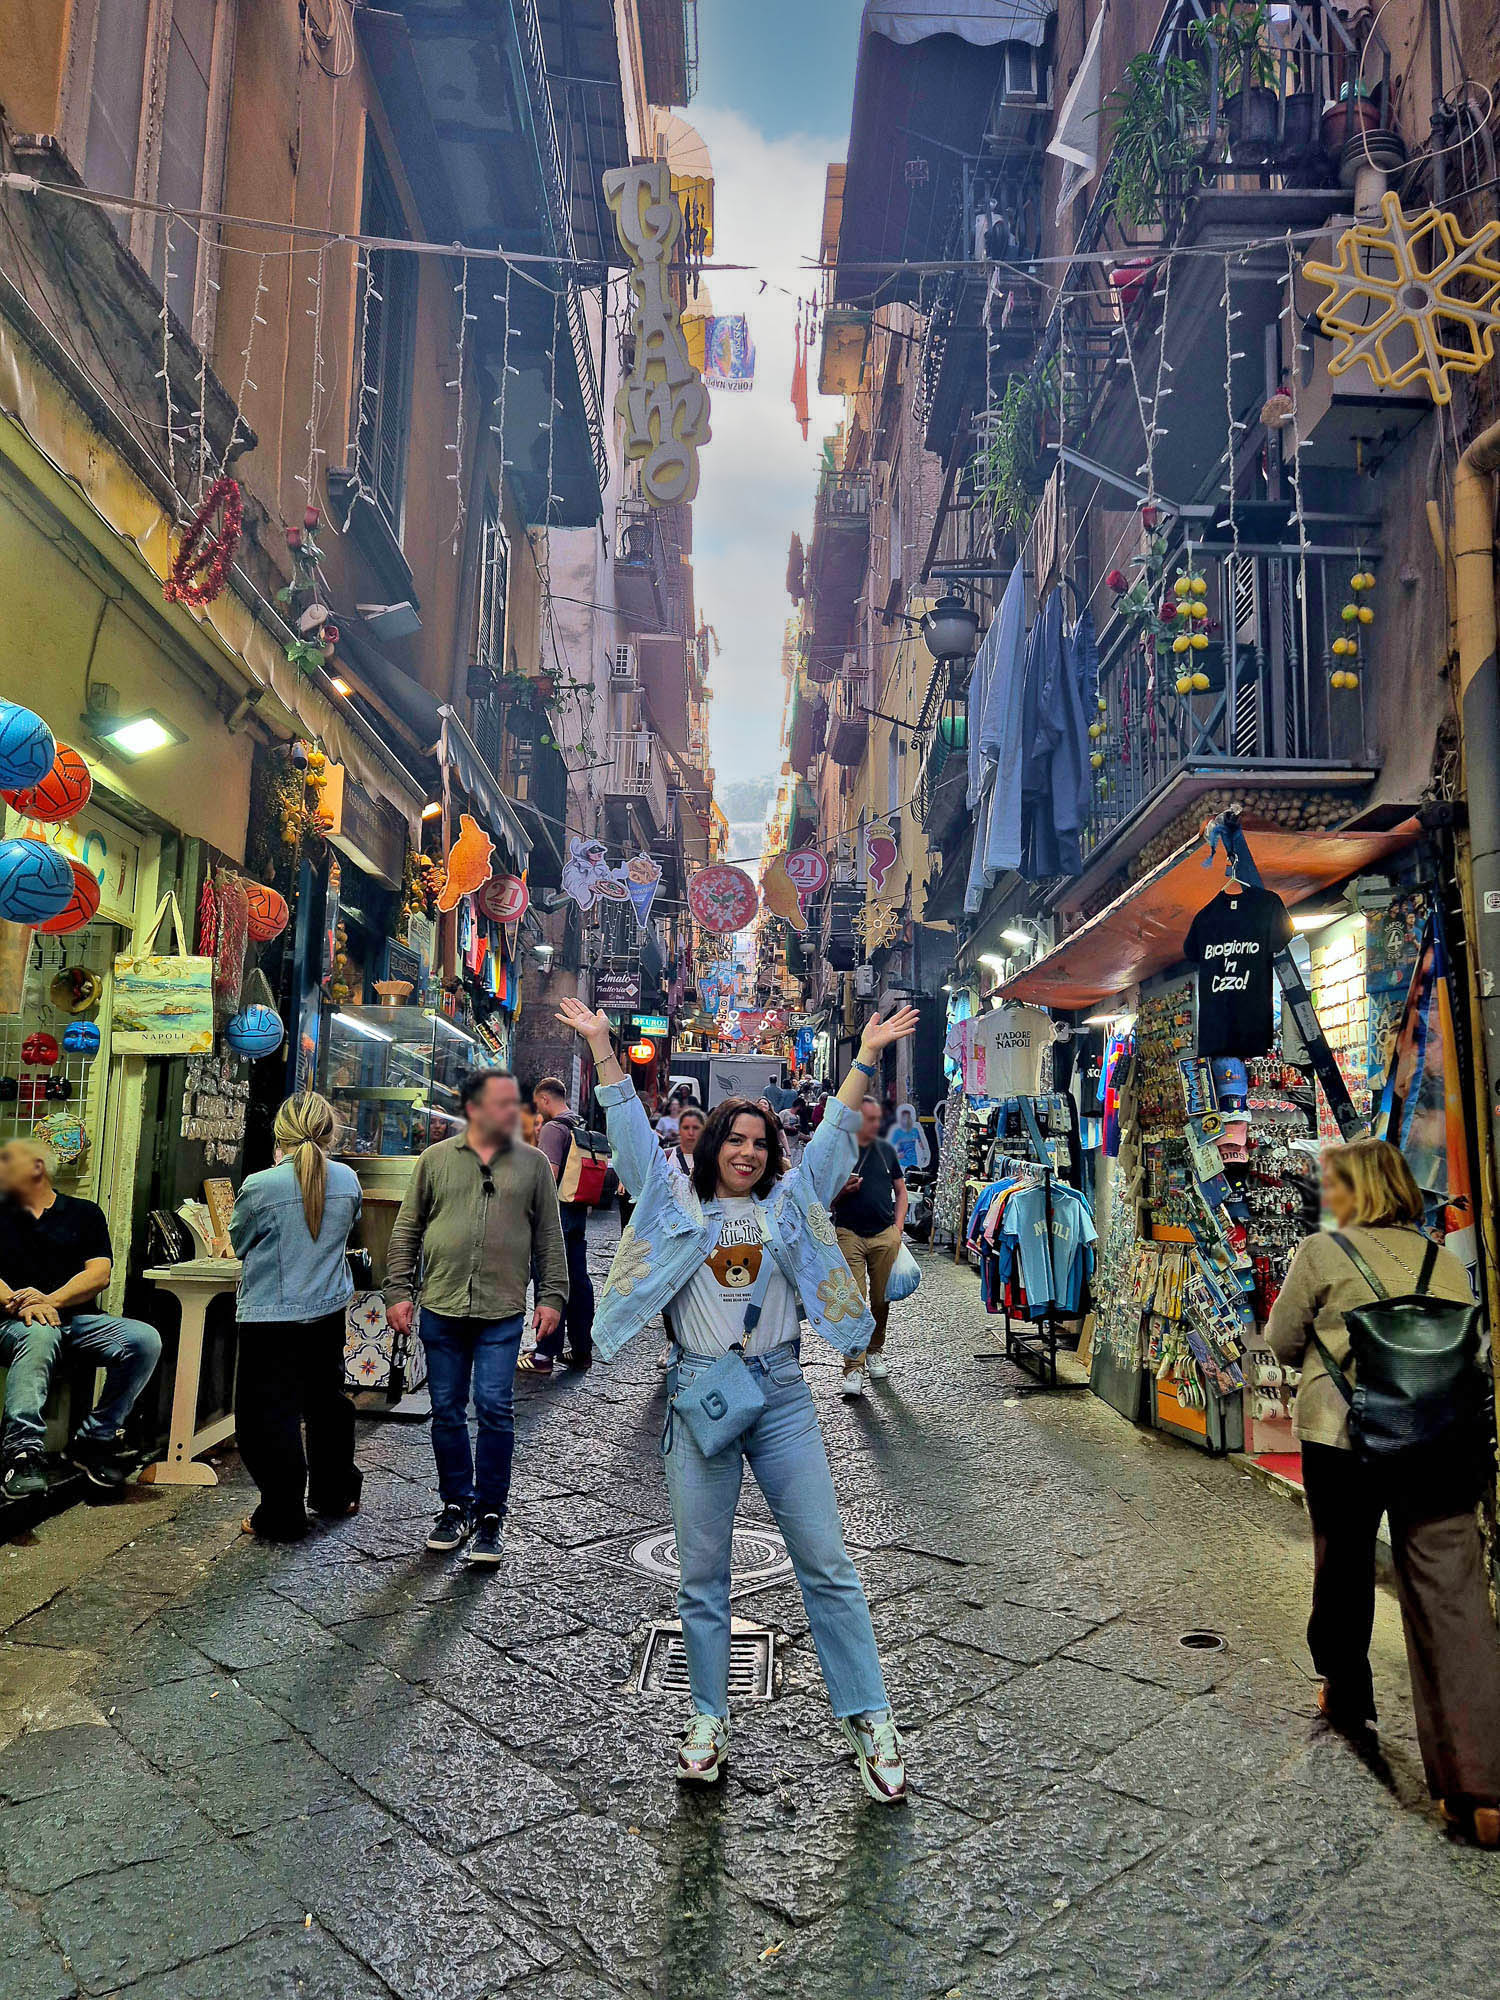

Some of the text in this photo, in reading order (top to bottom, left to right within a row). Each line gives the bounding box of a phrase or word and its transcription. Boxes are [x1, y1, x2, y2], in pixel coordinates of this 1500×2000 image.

[728, 381, 753, 392] FORZA
[791, 858, 820, 878] 21
[487, 882, 520, 909] 21
[1387, 930, 1403, 951] 4
[142, 1032, 184, 1040] NAPOLI
[804, 1032, 812, 1044] 8
[995, 1030, 1032, 1041] J'ADORE
[996, 1039, 1031, 1049] NAPOLI
[1182, 1059, 1205, 1113] NAPOLI
[721, 1225, 763, 1245] ILIN
